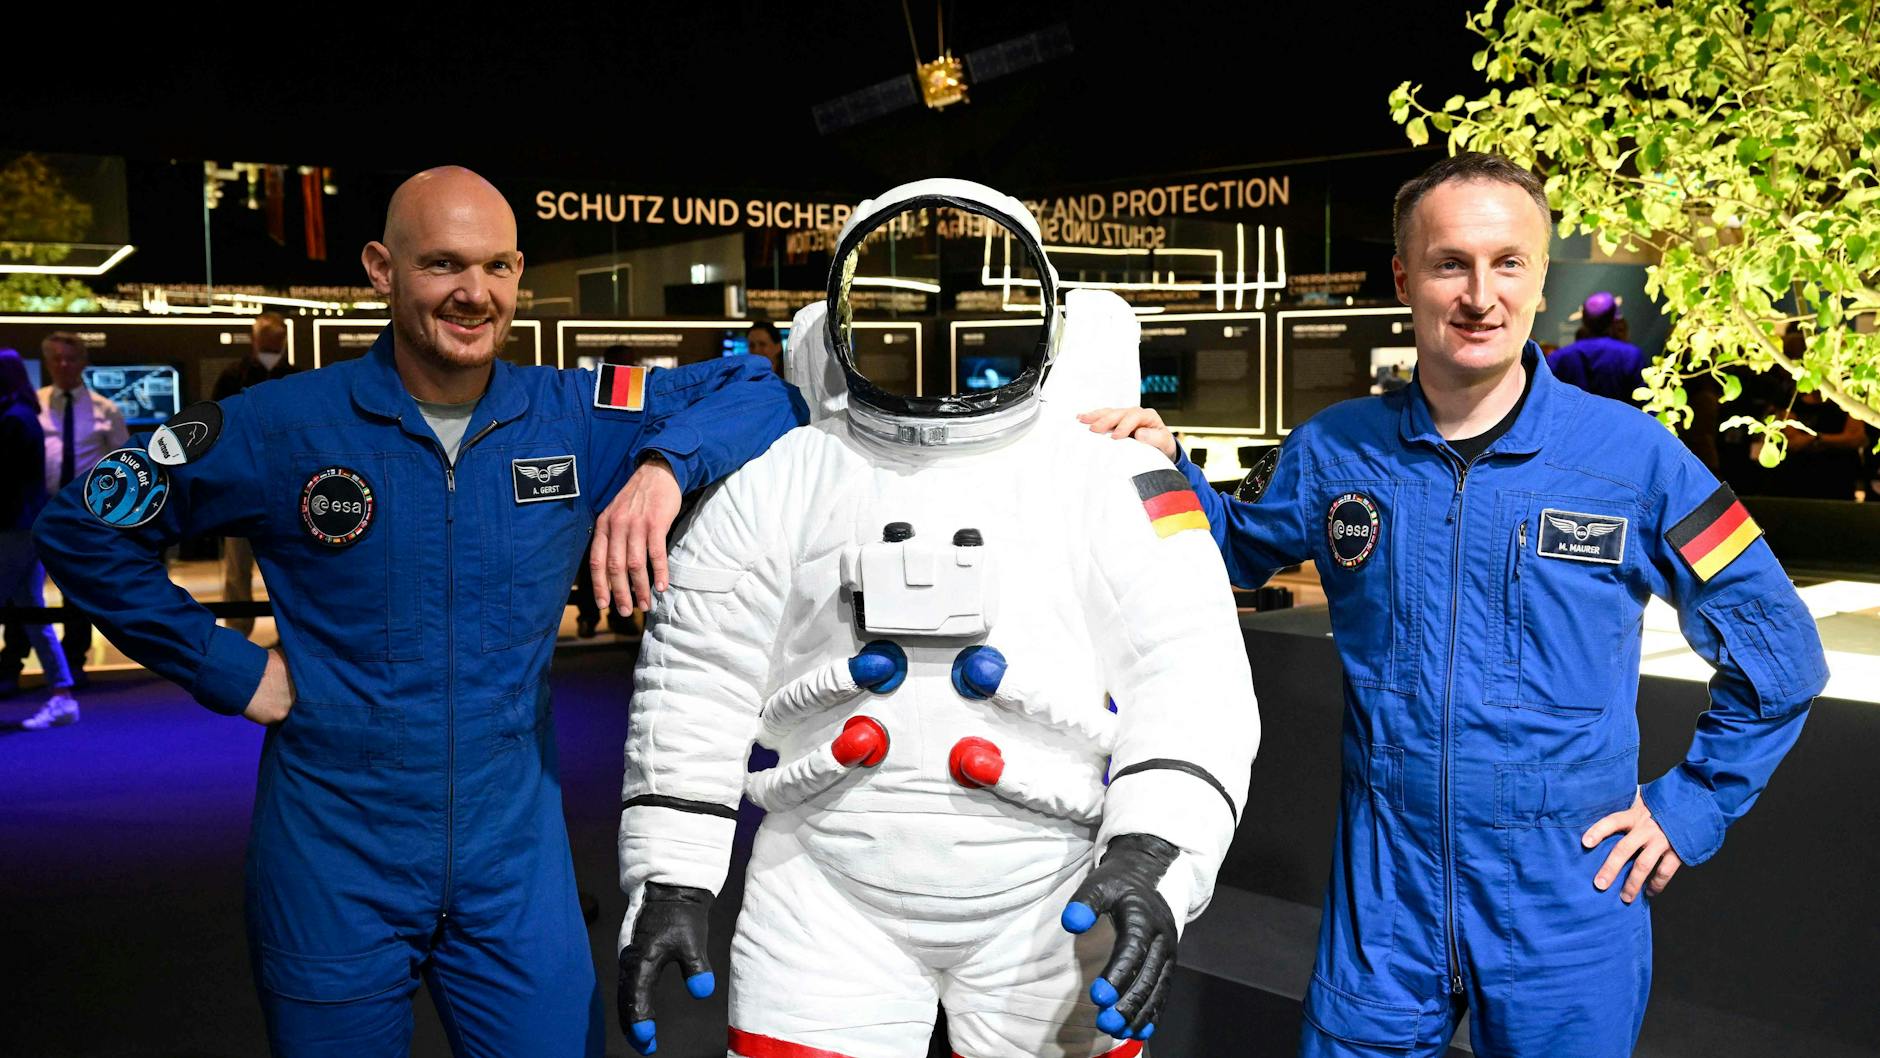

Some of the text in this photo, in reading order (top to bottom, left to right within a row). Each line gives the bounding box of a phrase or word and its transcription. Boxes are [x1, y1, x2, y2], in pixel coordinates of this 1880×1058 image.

[535, 190, 665, 225] SCHUTZ
[672, 197, 739, 227] UND
[1052, 193, 1106, 222] AND
[1112, 175, 1290, 218] PROTECTION
[120, 453, 149, 487] blue dot
[533, 485, 560, 495] A. GERST
[1558, 542, 1600, 555] M. MAURER
